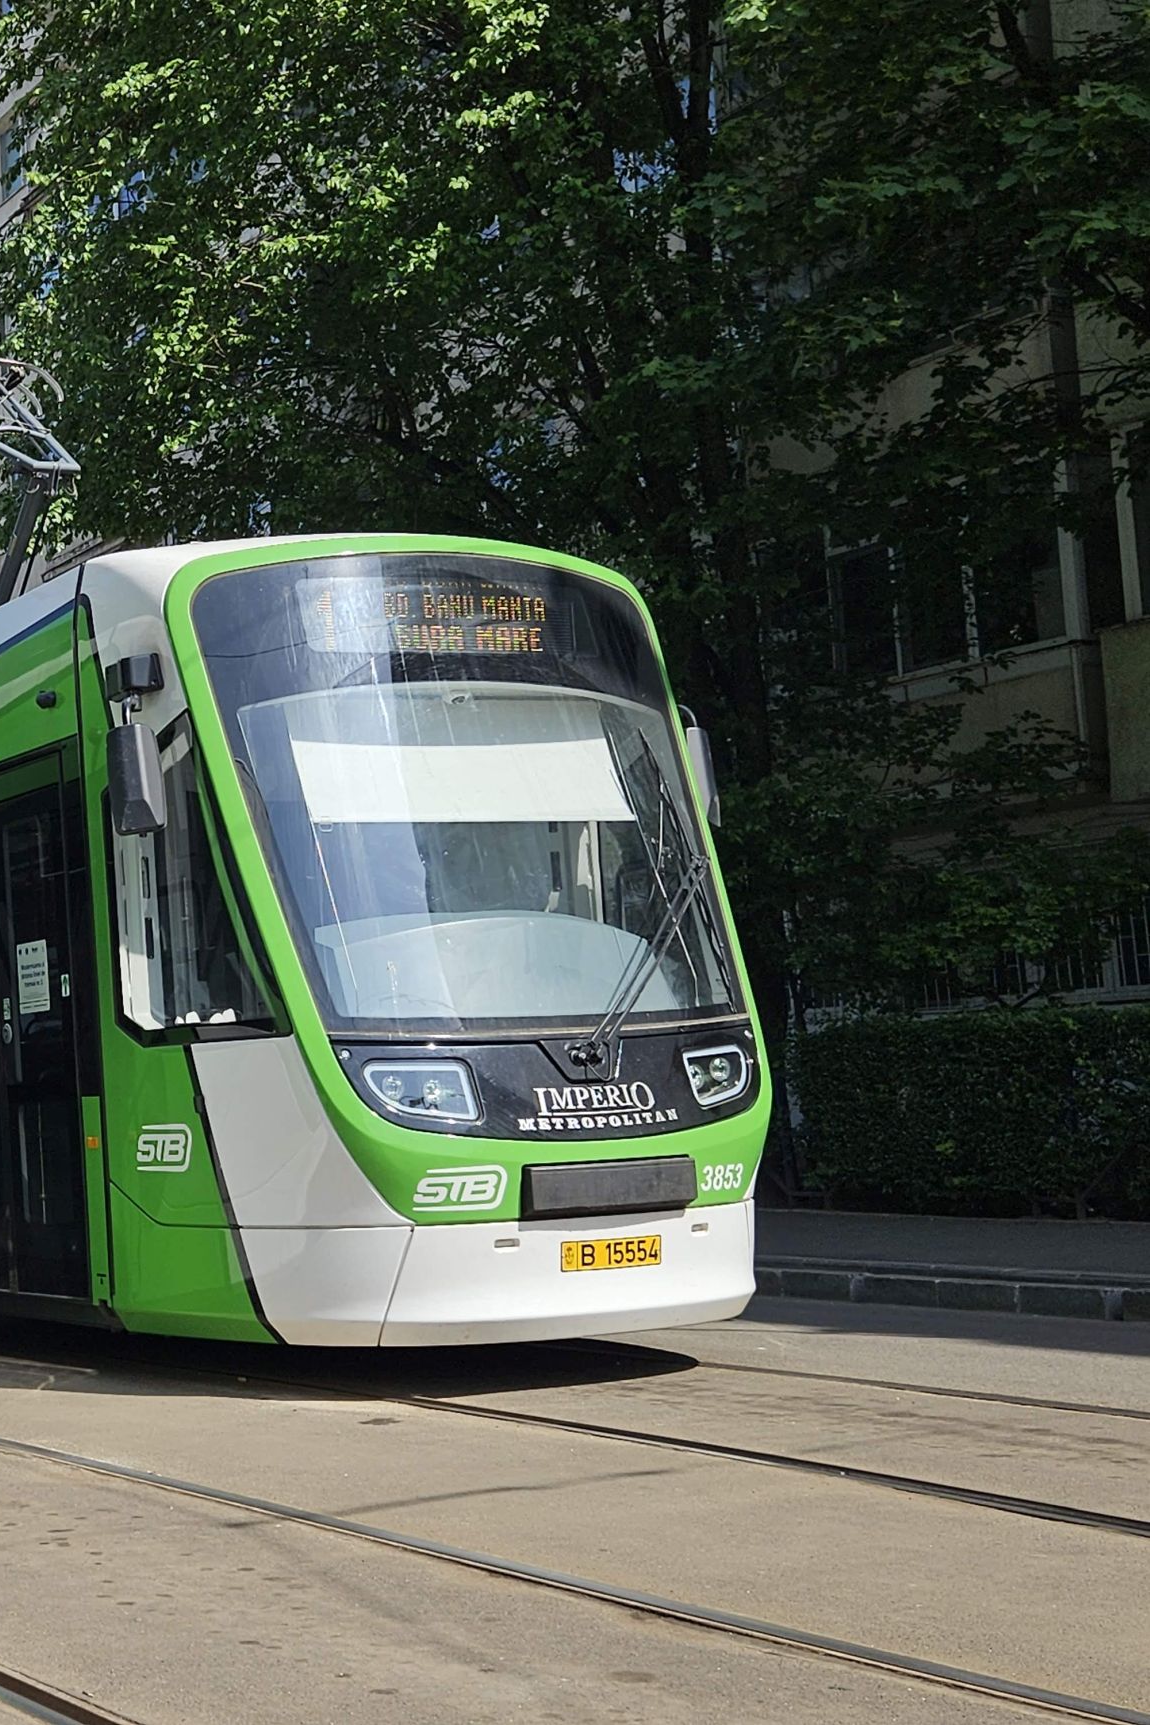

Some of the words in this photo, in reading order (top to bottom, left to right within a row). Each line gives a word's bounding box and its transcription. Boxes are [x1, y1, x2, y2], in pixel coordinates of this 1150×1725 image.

[316, 590, 335, 651] 1
[423, 592, 475, 620] BANU
[481, 595, 547, 622] MANTA
[475, 625, 544, 653] MARE
[533, 1080, 656, 1117] IMPERIO
[518, 1108, 680, 1132] METROPOLITAN
[136, 1132, 186, 1163] STB
[413, 1172, 497, 1204] STB
[700, 1163, 744, 1192] 3853
[581, 1244, 596, 1267] B
[605, 1238, 659, 1266] 15554
